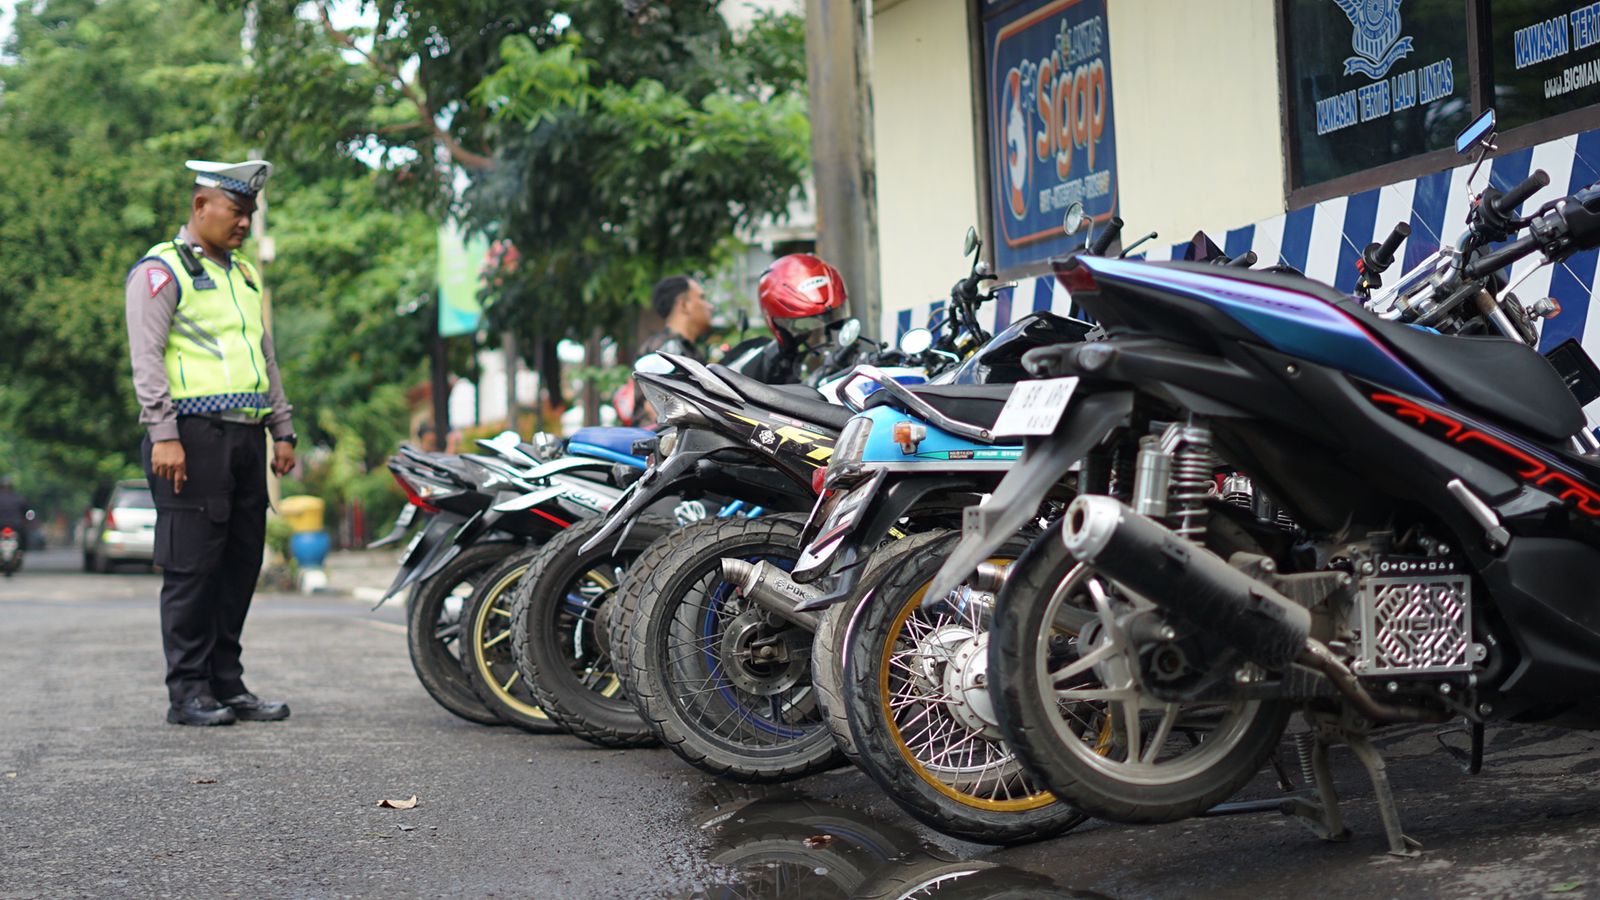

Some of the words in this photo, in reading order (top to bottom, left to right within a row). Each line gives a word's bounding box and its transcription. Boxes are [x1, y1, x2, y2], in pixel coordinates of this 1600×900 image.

[1514, 14, 1569, 70] KAWASAN
[1036, 50, 1106, 181] Sigap
[1316, 89, 1358, 136] KAWASAN
[1359, 79, 1390, 122] TERTIB
[1392, 70, 1417, 112] LALU
[1418, 57, 1454, 105] LINTAS
